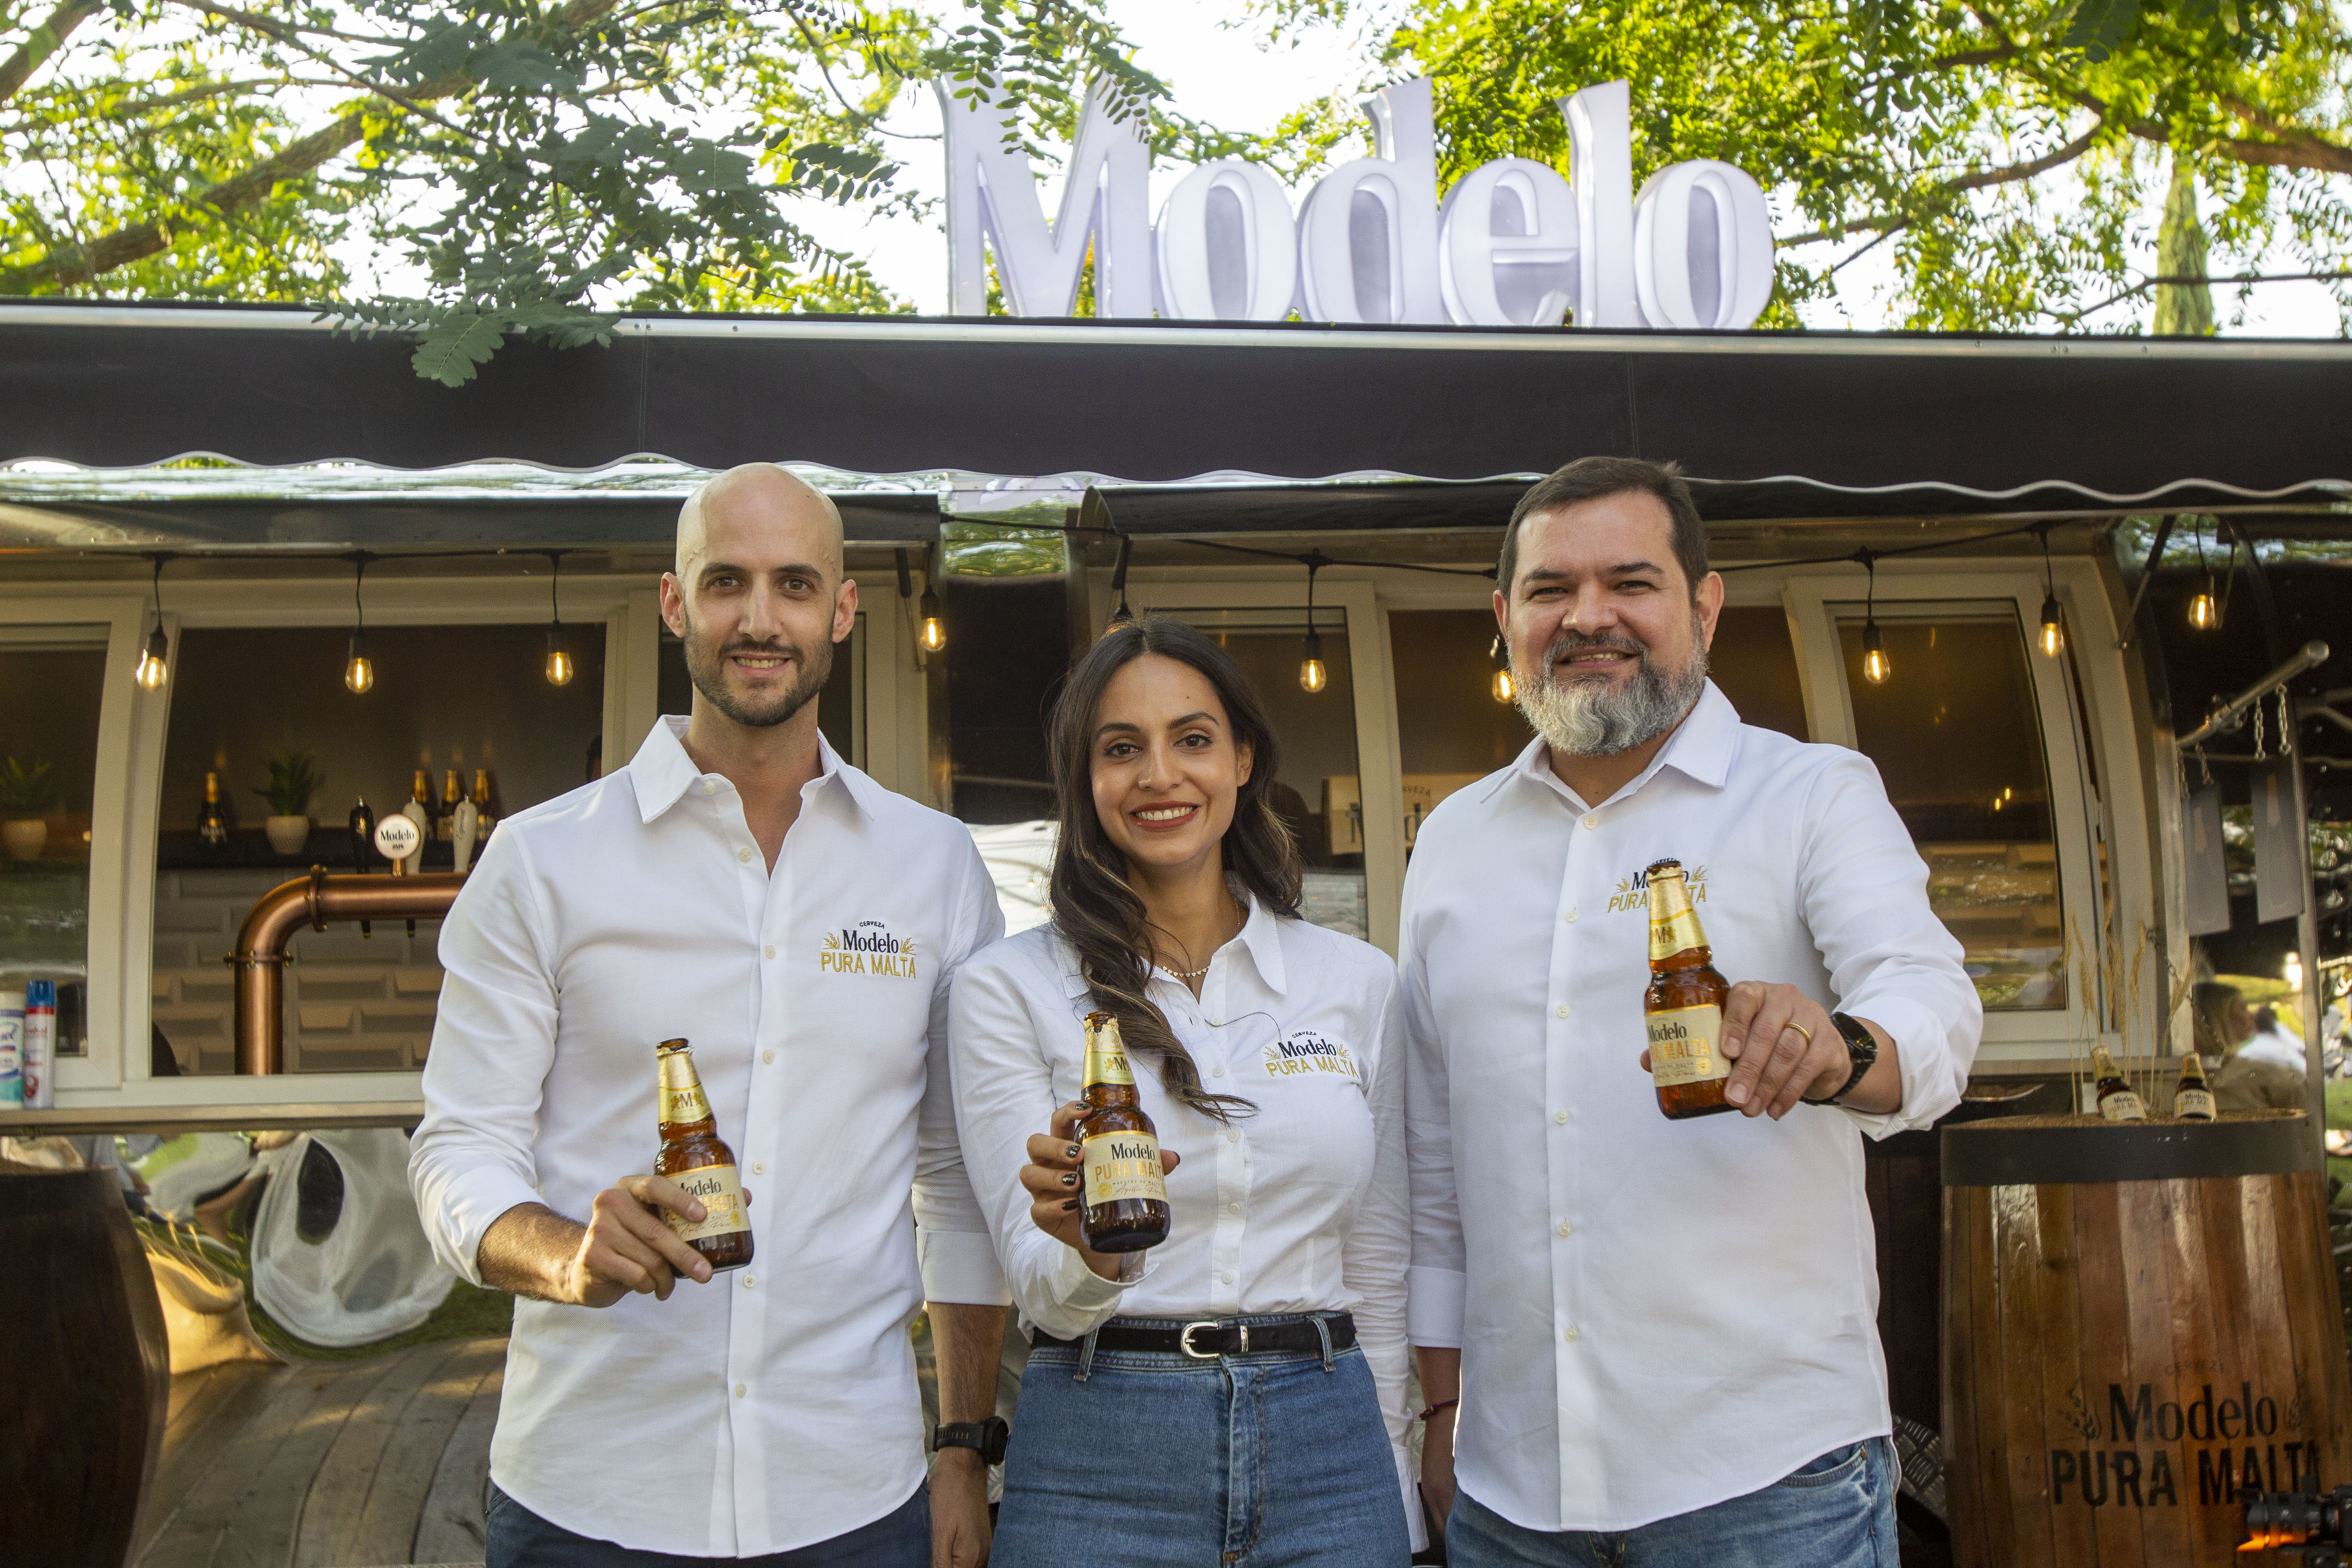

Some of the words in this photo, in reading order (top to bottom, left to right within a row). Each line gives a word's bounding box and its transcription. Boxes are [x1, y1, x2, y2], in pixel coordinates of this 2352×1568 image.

[934, 72, 1776, 329] Modelo
[380, 829, 414, 841] Modelo
[1608, 890, 1648, 913] PURA
[859, 921, 885, 929] CERVEZA
[842, 929, 899, 954] Modelo
[821, 952, 865, 974] PURA
[871, 954, 916, 979] MALTA
[1278, 1039, 1337, 1059] Modelo
[1265, 1058, 1314, 1077] PURA
[1313, 1056, 1360, 1079] MALTA
[1111, 1143, 1156, 1161] Modelo
[1094, 1161, 1132, 1183] PURA
[681, 1178, 721, 1196] odelo
[2108, 1382, 2278, 1443] Modelo
[2051, 1450, 2177, 1508] PURA
